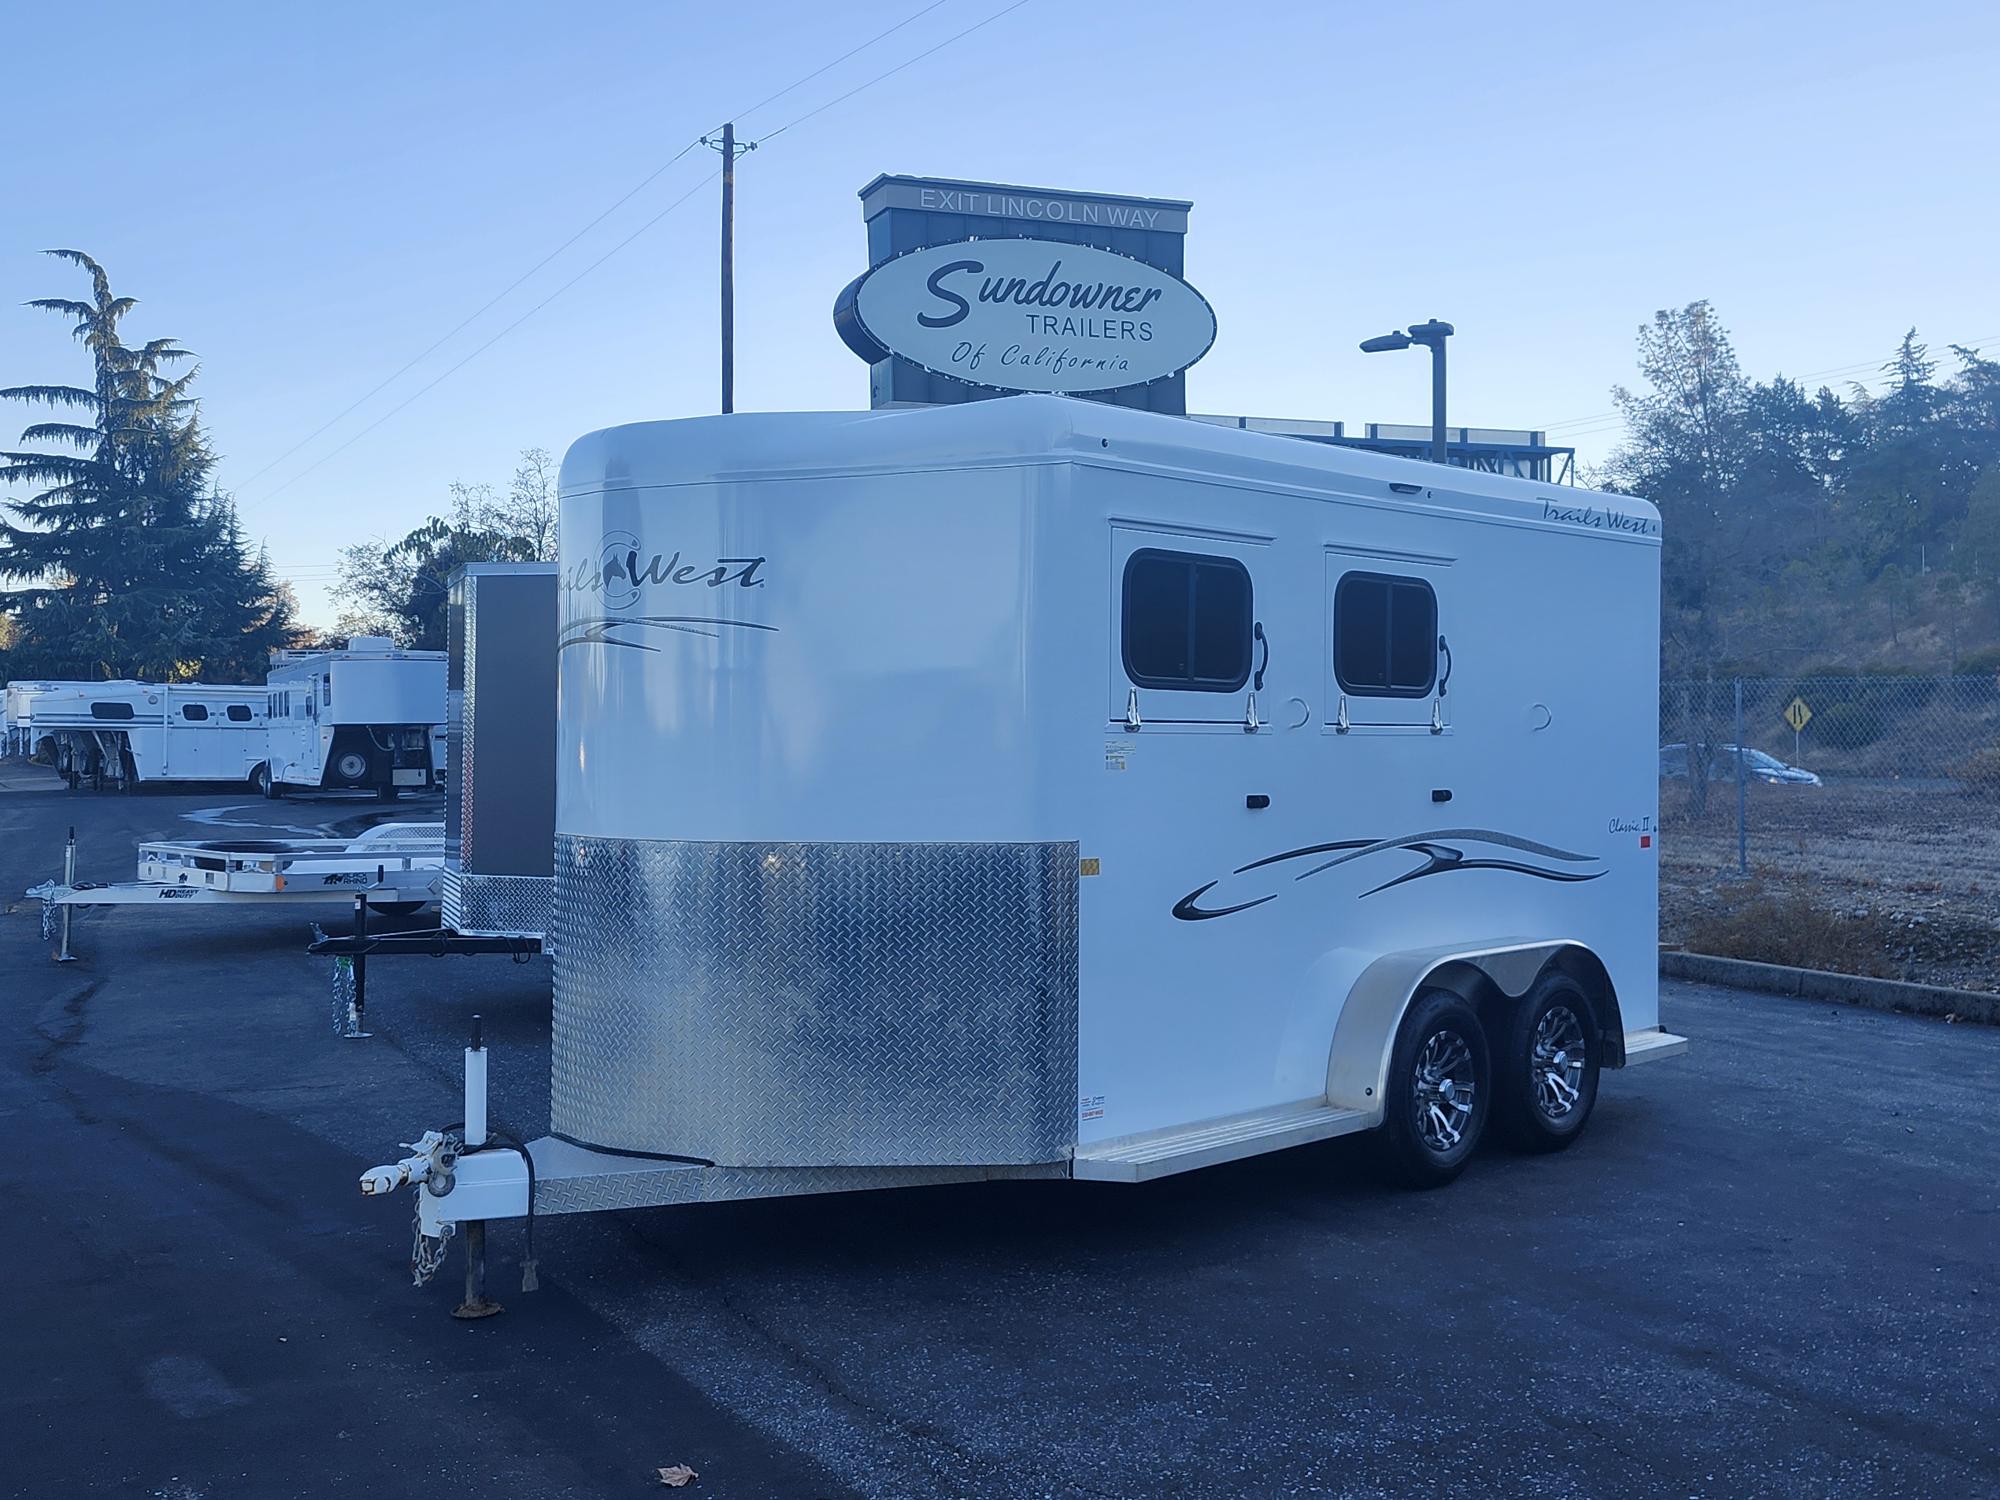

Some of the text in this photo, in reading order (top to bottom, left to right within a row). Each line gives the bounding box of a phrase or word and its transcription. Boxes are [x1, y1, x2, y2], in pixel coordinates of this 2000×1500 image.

[920, 188, 1161, 230] EXIT LINCOLN WAY
[916, 259, 1164, 328] Sundowner
[1025, 313, 1154, 342] TRAILERS
[951, 341, 1130, 376] Of California
[1536, 496, 1649, 534] Trails West
[625, 550, 767, 590] West
[158, 889, 177, 899] HD
